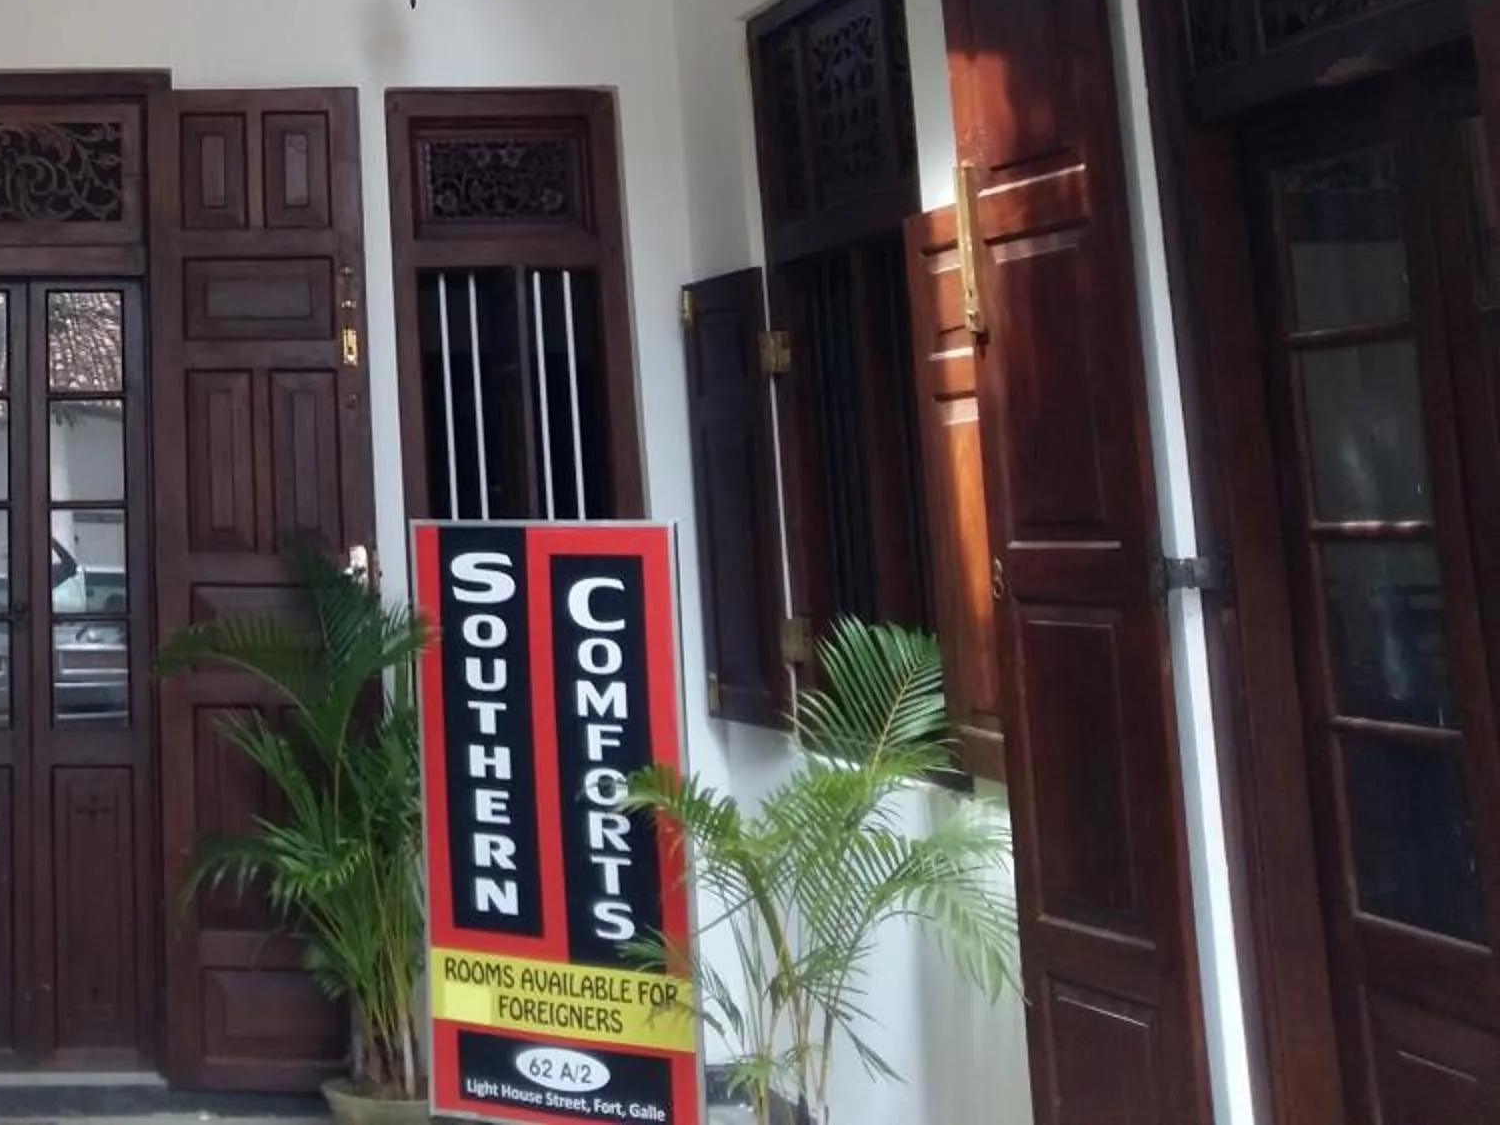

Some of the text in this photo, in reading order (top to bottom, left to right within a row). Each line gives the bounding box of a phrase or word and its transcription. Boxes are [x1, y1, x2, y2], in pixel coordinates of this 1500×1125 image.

[450, 552, 518, 915] SOUTHERN
[567, 577, 636, 940] COMFORTS
[445, 957, 678, 1007] ROOMS AVAILABLE FOR
[499, 995, 623, 1034] FOREIGNERS
[529, 1057, 592, 1084] 62 A/2
[467, 1078, 665, 1122] Light House Street, Fort, Galle
